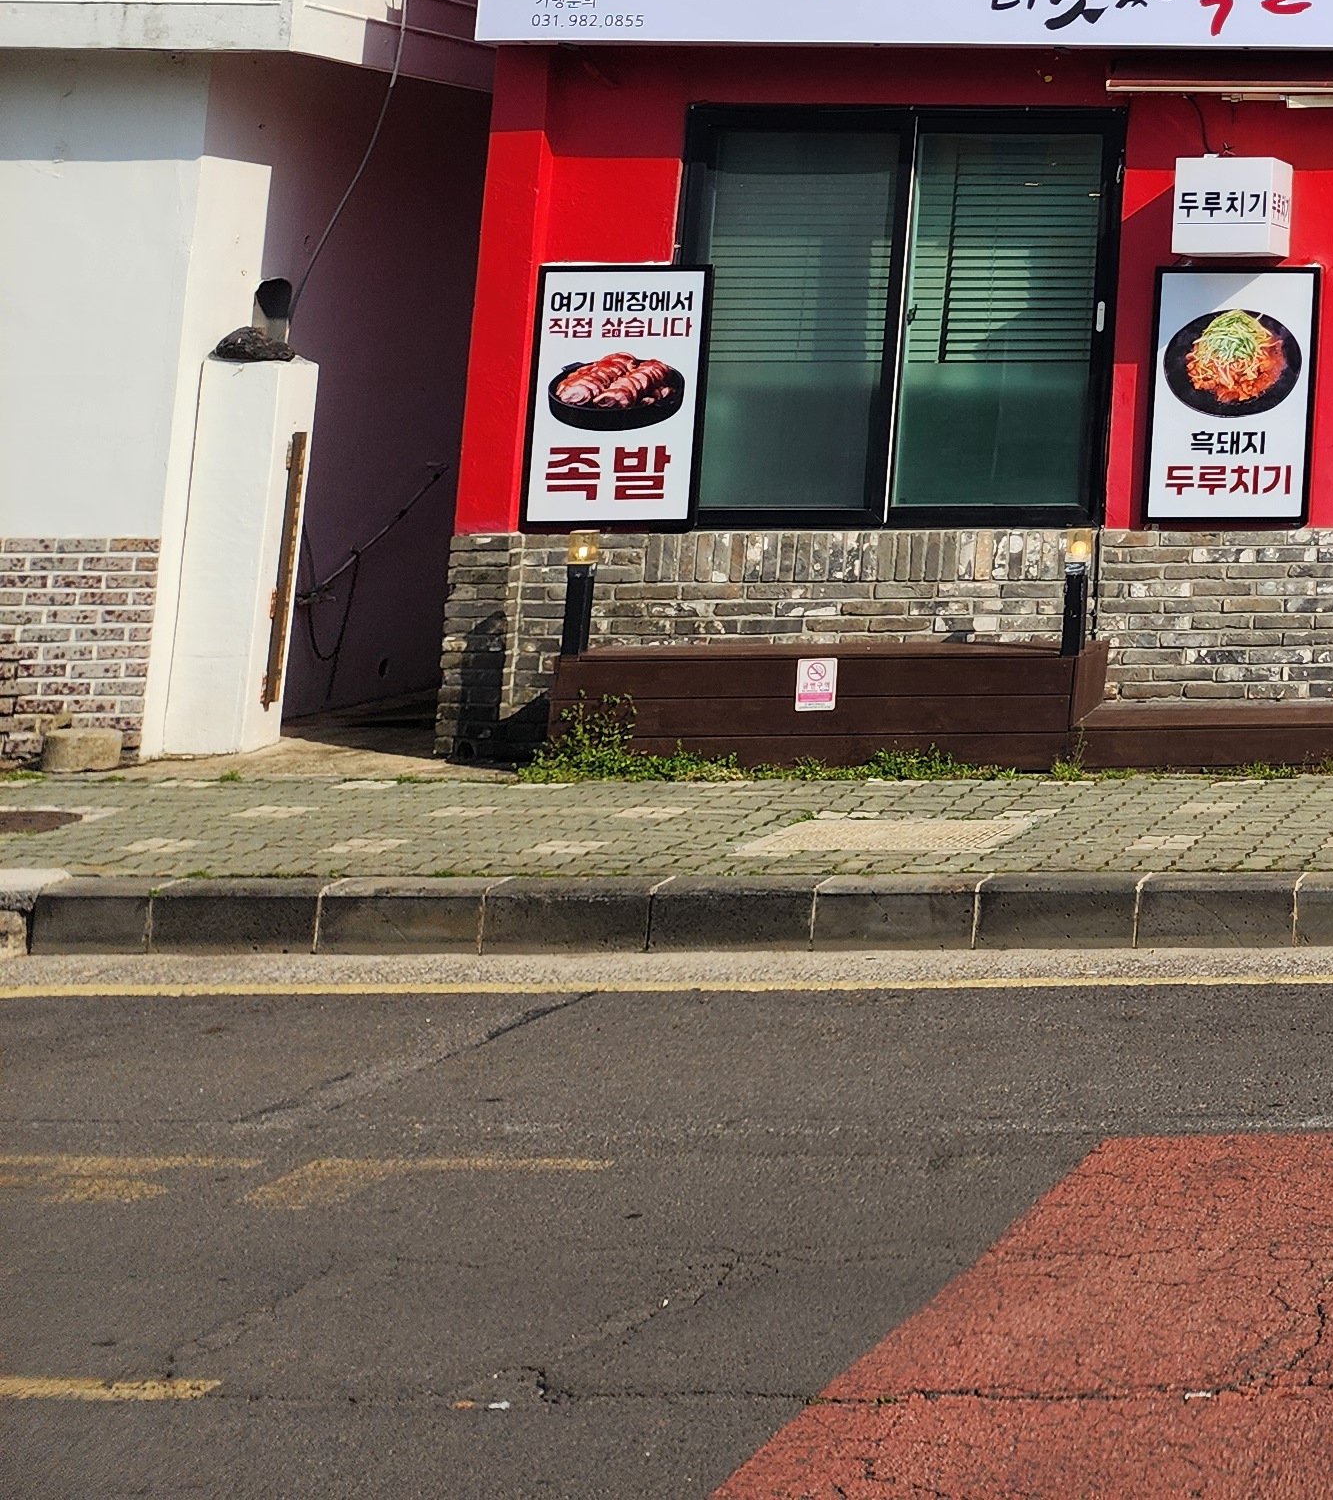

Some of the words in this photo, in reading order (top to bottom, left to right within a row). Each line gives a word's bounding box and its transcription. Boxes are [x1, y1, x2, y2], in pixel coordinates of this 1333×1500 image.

[1178, 190, 1268, 218] 두루치기
[550, 291, 595, 312] 여기
[602, 291, 694, 312] 매장에서
[549, 317, 594, 339] 직접
[601, 317, 693, 339] 삶습니다
[1190, 431, 1266, 455] 흑돼지
[545, 445, 672, 501] 족발
[1165, 465, 1292, 495] 두루치기
